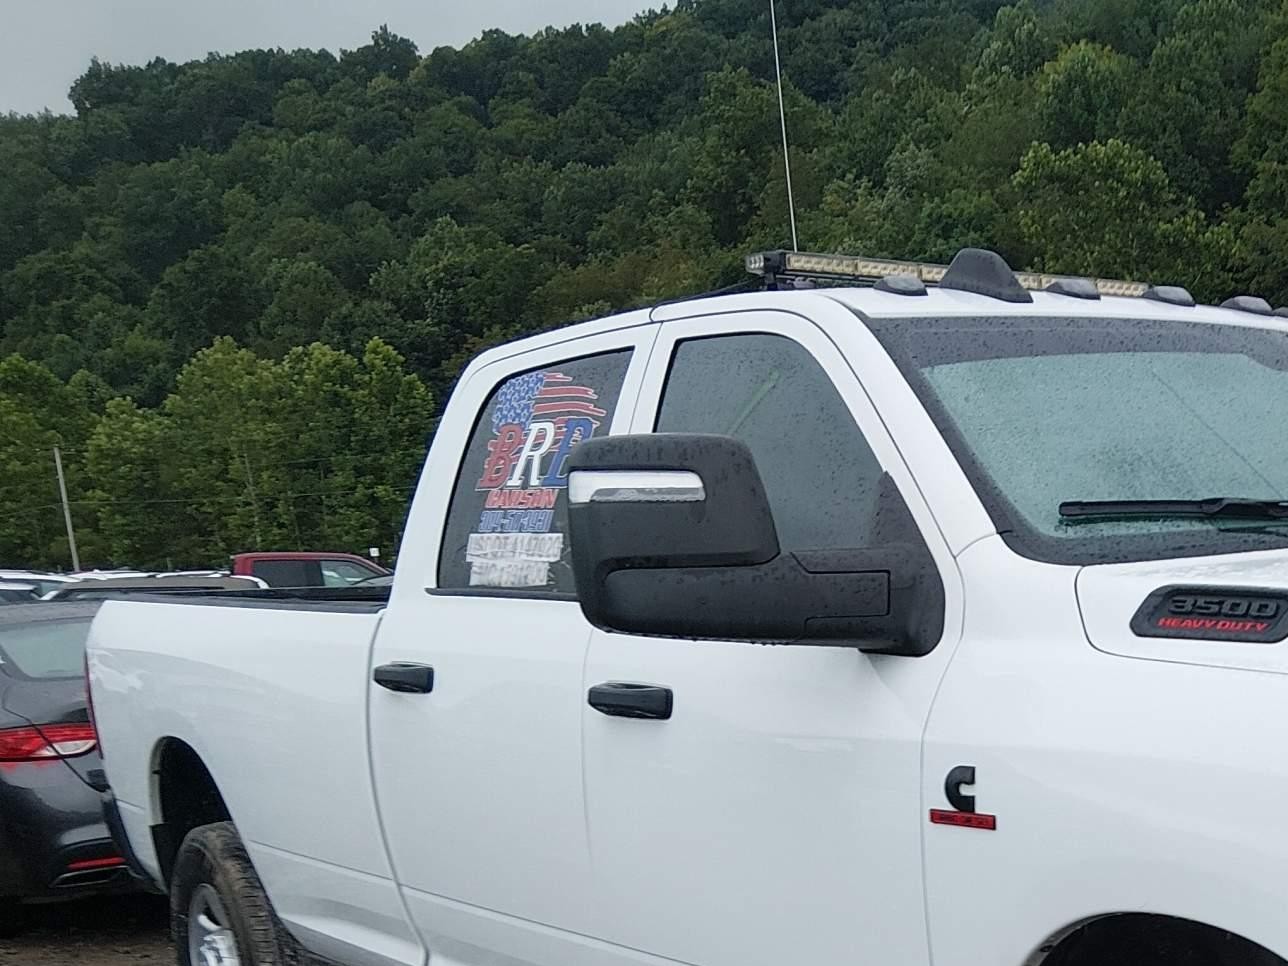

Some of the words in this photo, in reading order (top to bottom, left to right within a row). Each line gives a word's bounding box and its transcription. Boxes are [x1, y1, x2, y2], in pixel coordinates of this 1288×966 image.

[1168, 596, 1279, 618] 3500
[1158, 617, 1218, 630] HEAVY
[1218, 620, 1269, 632] DUTY
